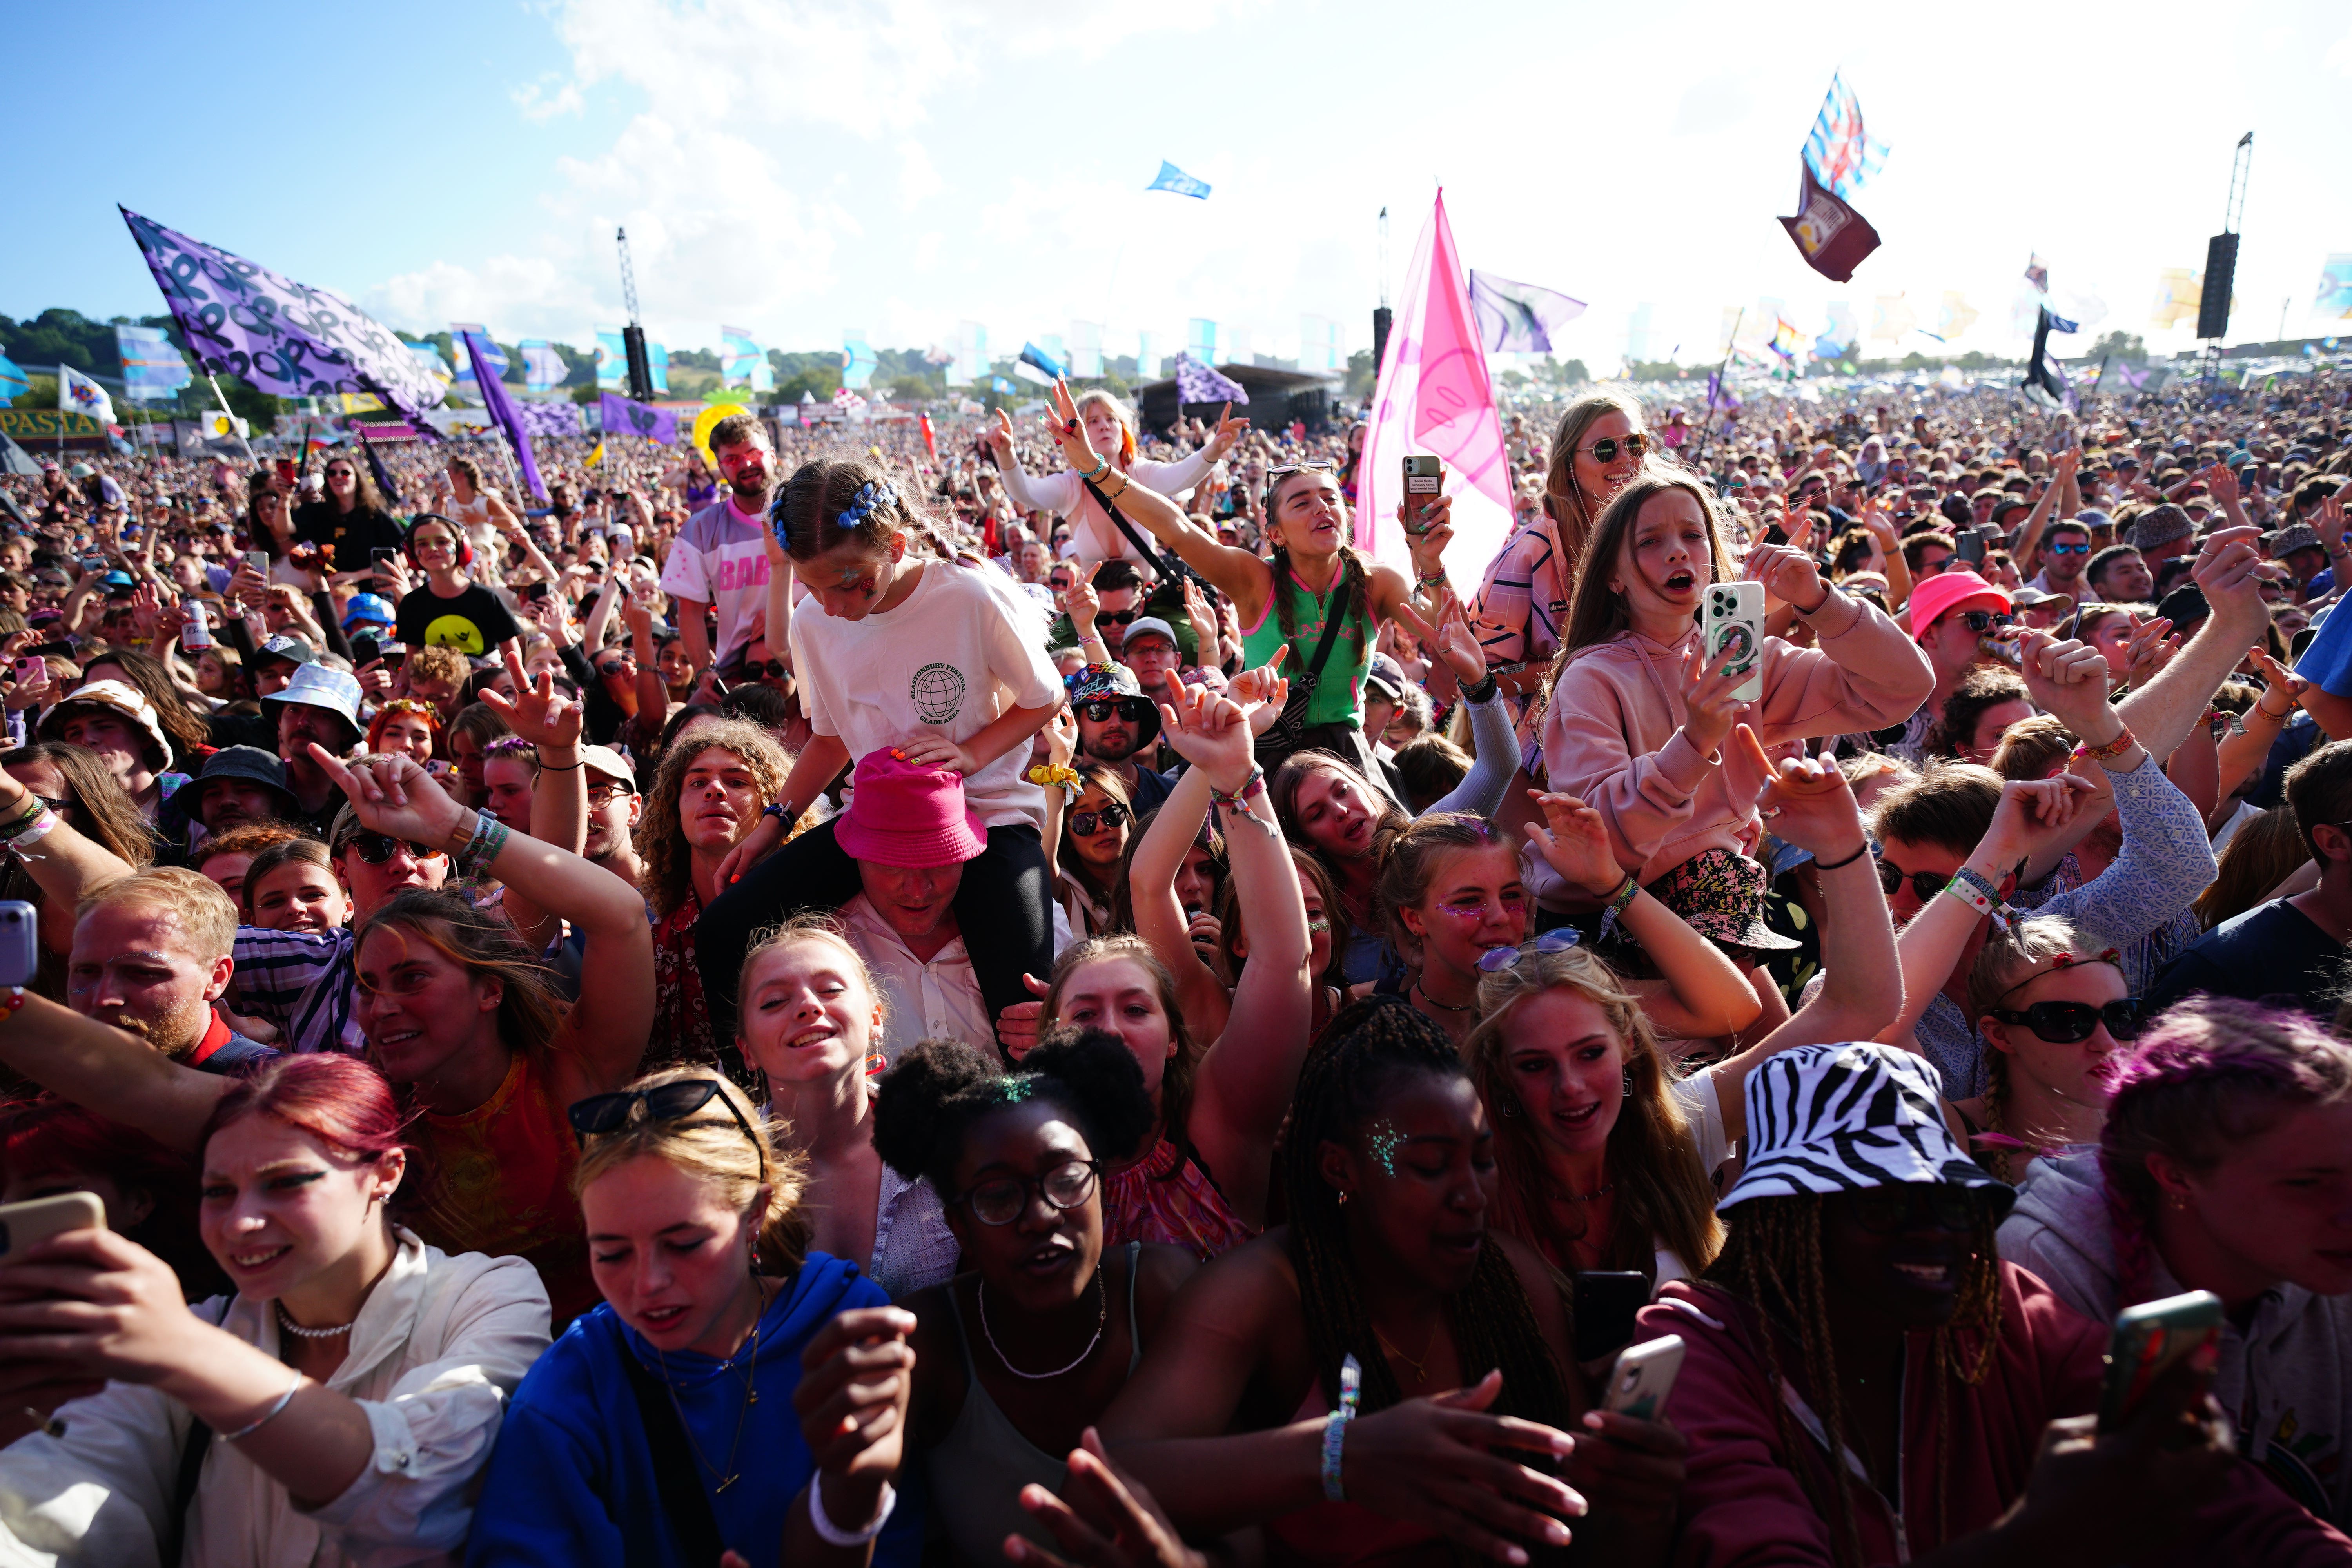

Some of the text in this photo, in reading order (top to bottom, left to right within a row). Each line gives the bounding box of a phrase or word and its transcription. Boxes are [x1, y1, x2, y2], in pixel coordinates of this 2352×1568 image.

[0, 412, 96, 433] PASTA
[911, 663, 965, 699] GLASTONBURY FESTIVAL
[920, 709, 960, 725] GLADE AREA
